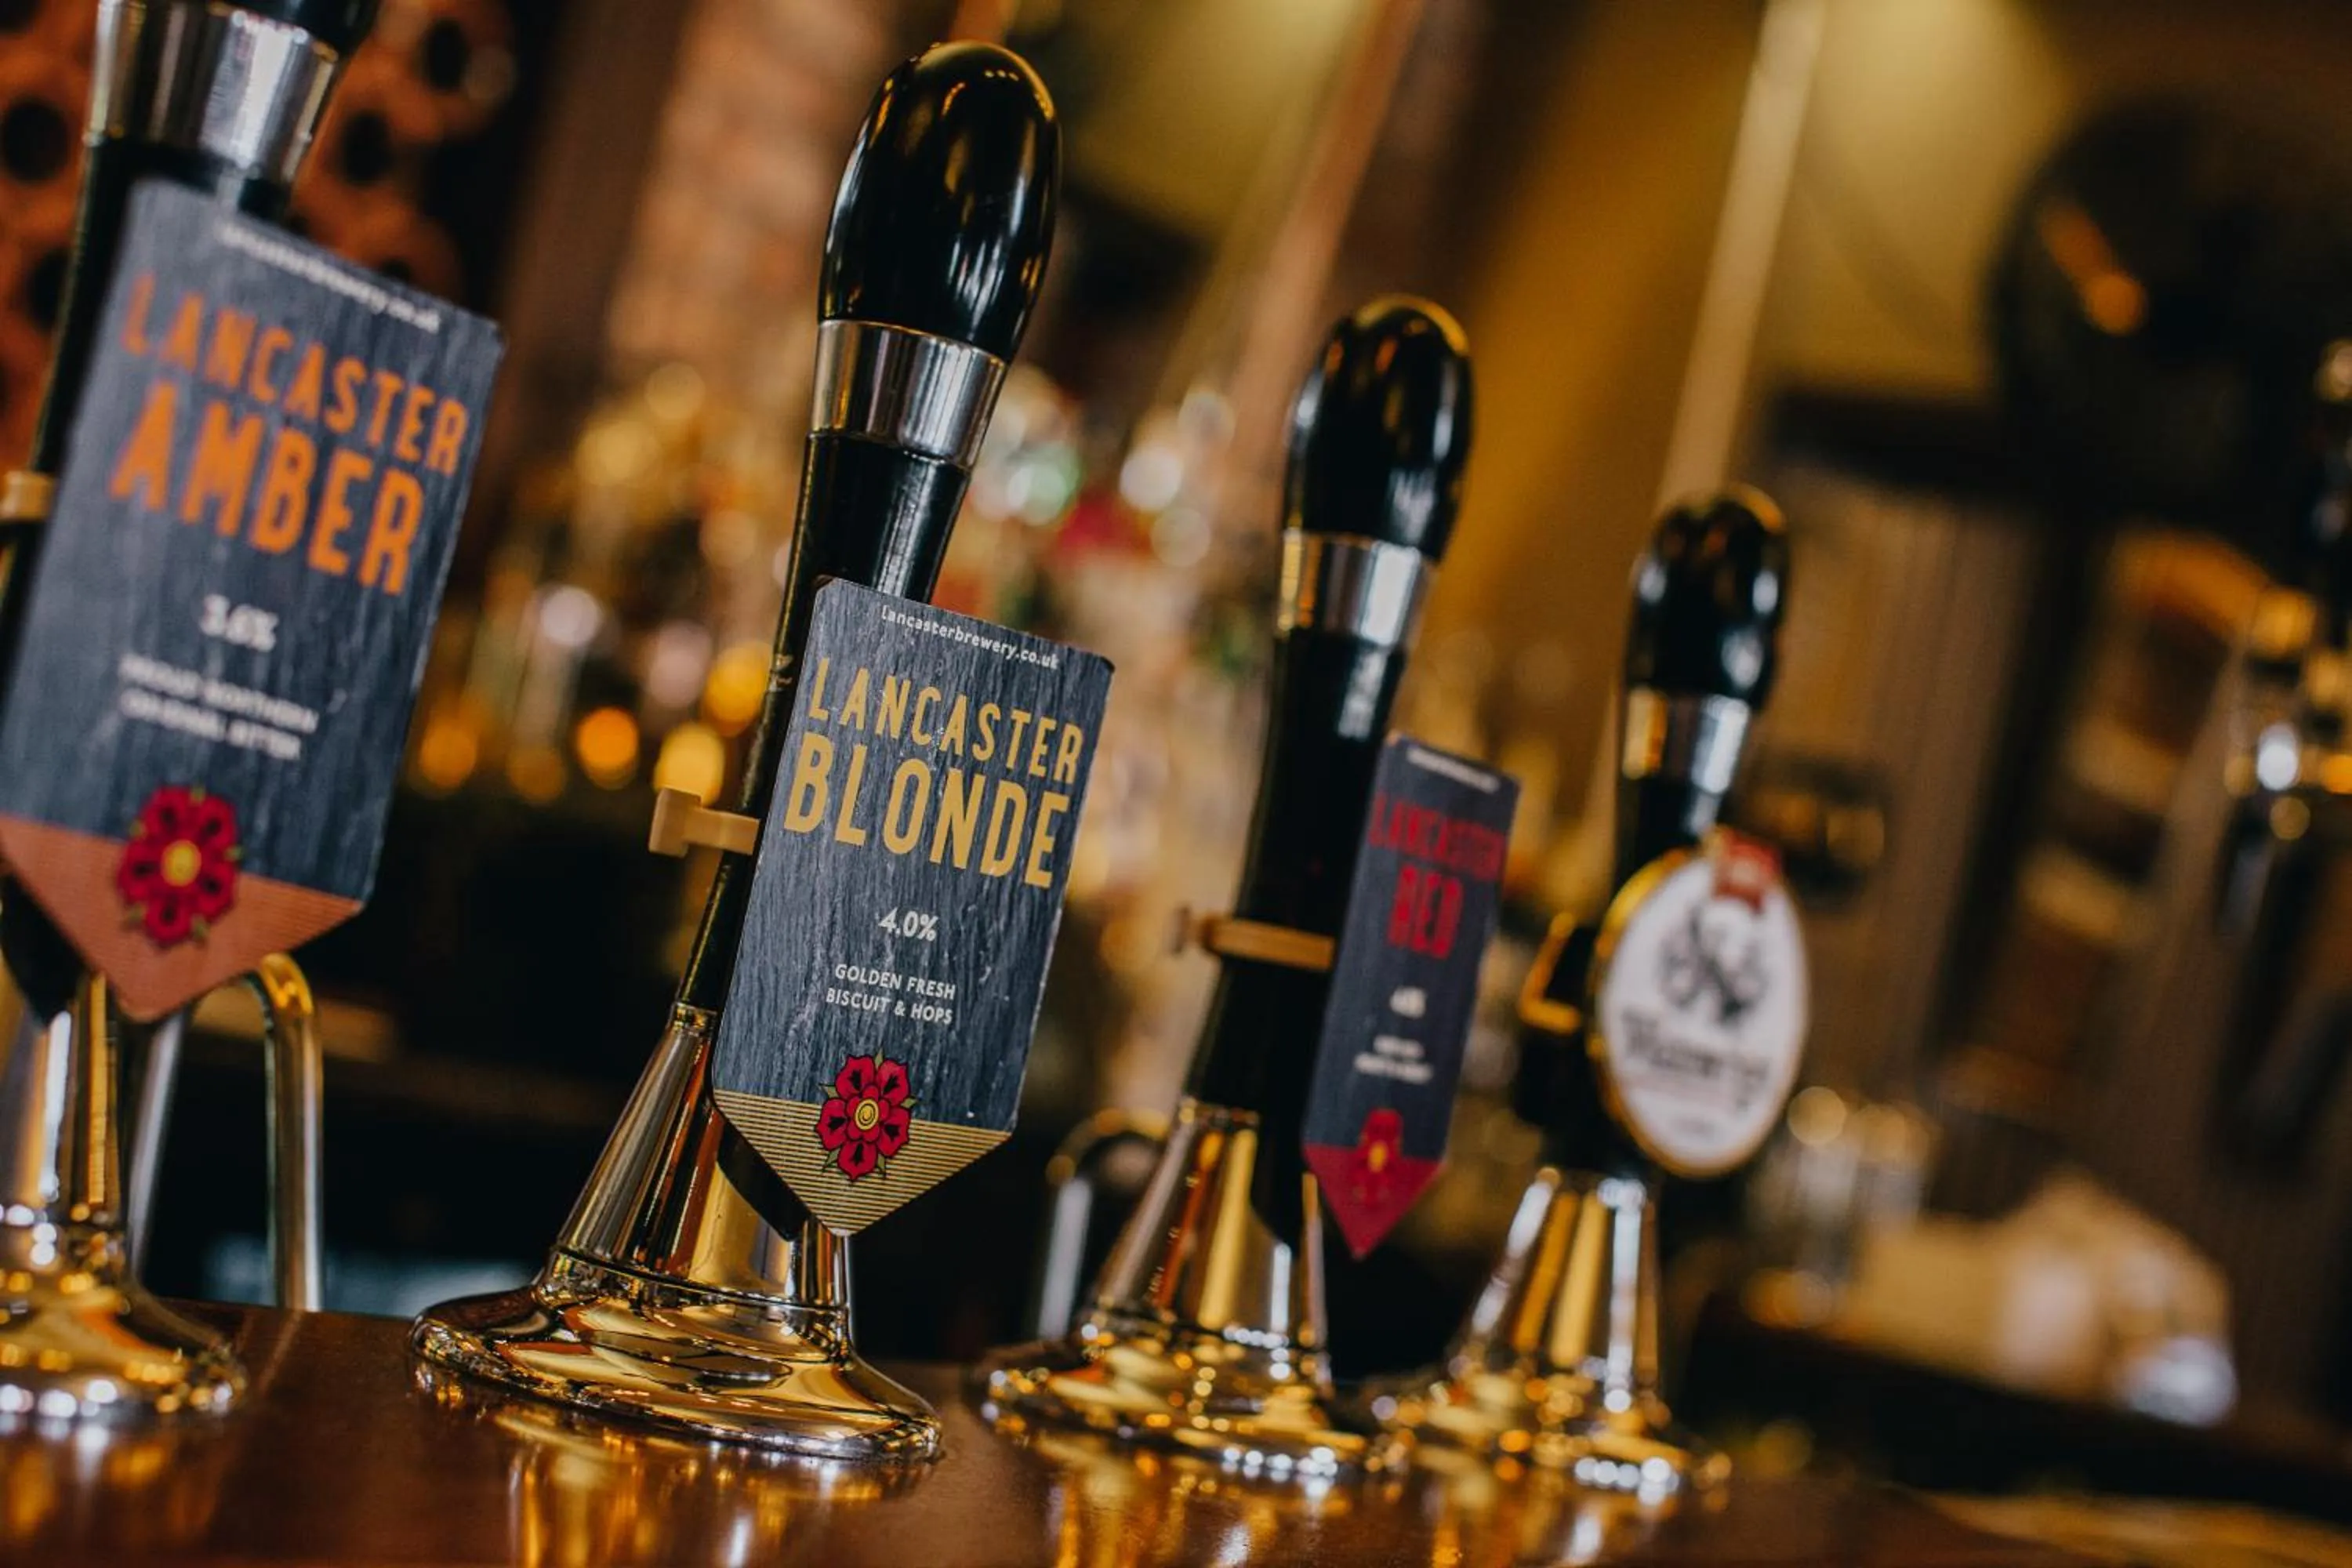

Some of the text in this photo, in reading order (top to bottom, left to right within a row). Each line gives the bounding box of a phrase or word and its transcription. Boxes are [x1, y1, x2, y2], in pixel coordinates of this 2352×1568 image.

[120, 271, 468, 477] LANCASTER
[107, 379, 425, 595] AMBER
[881, 604, 1060, 670] lancasterbrewery.co.uk
[806, 656, 1083, 784] LANCASTER
[783, 731, 1071, 889] BLONDE
[877, 906, 940, 942] 4.0%
[1386, 862, 1464, 960] RED
[826, 987, 953, 1025] BISCUIT & HOPS
[835, 964, 956, 1000] GOLDEN FRESH
